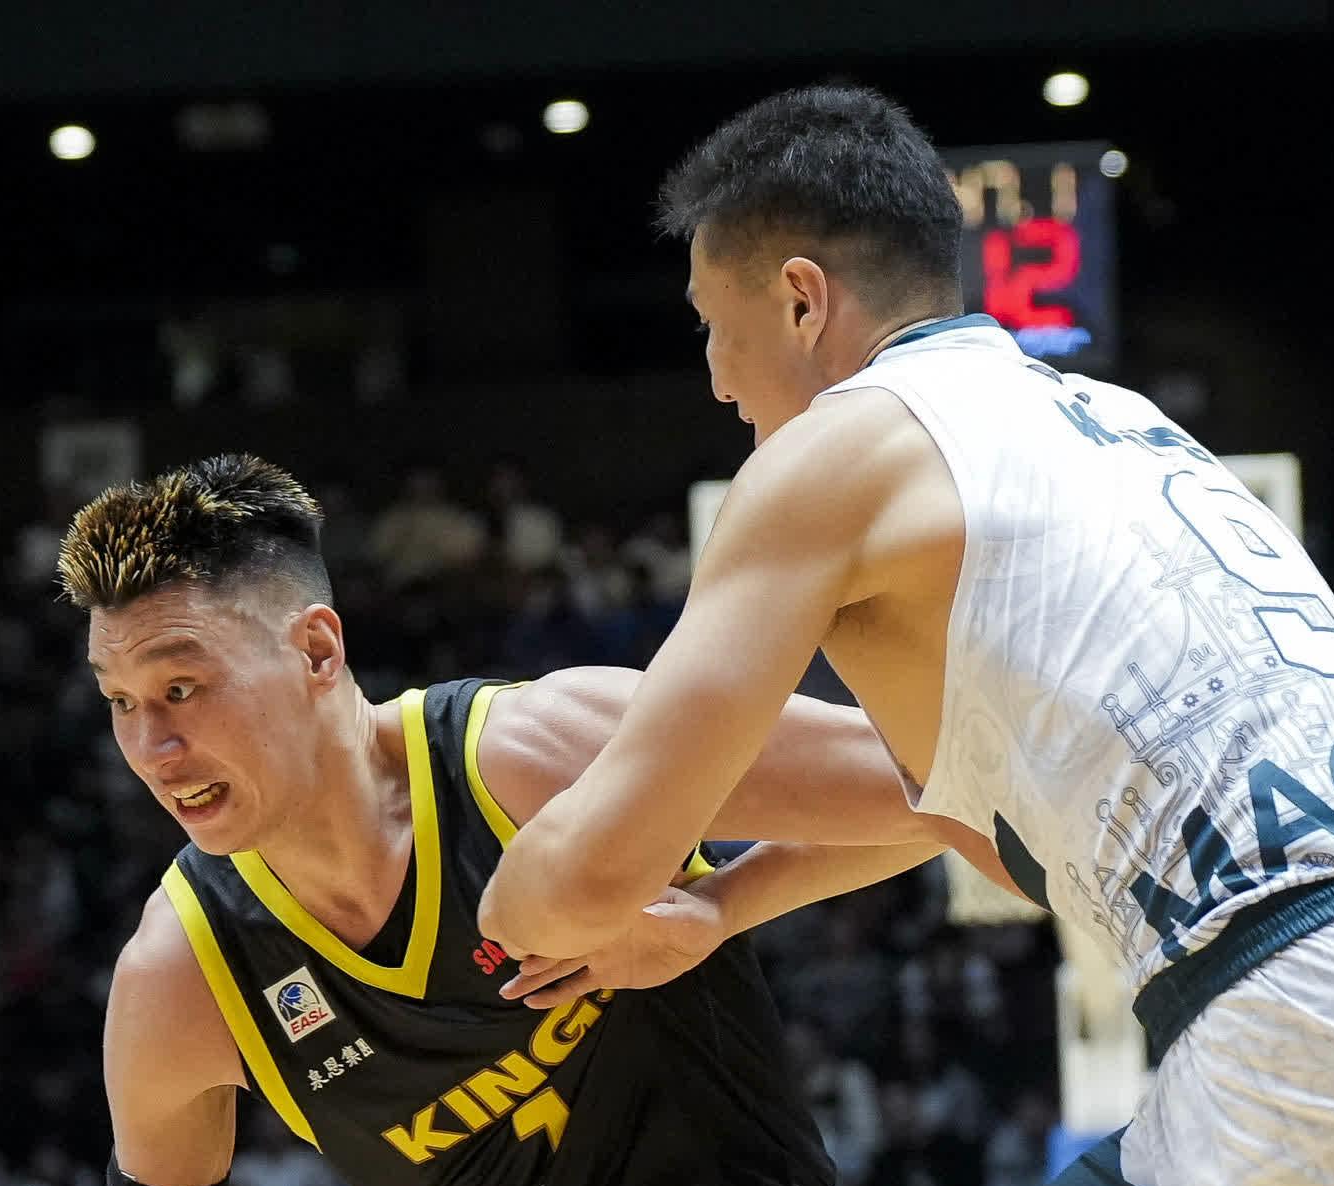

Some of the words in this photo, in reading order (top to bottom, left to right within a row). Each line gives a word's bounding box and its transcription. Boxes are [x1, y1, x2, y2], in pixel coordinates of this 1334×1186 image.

[981, 216, 1081, 330] 12
[290, 1006, 329, 1036] EASL
[381, 988, 615, 1165] KING
